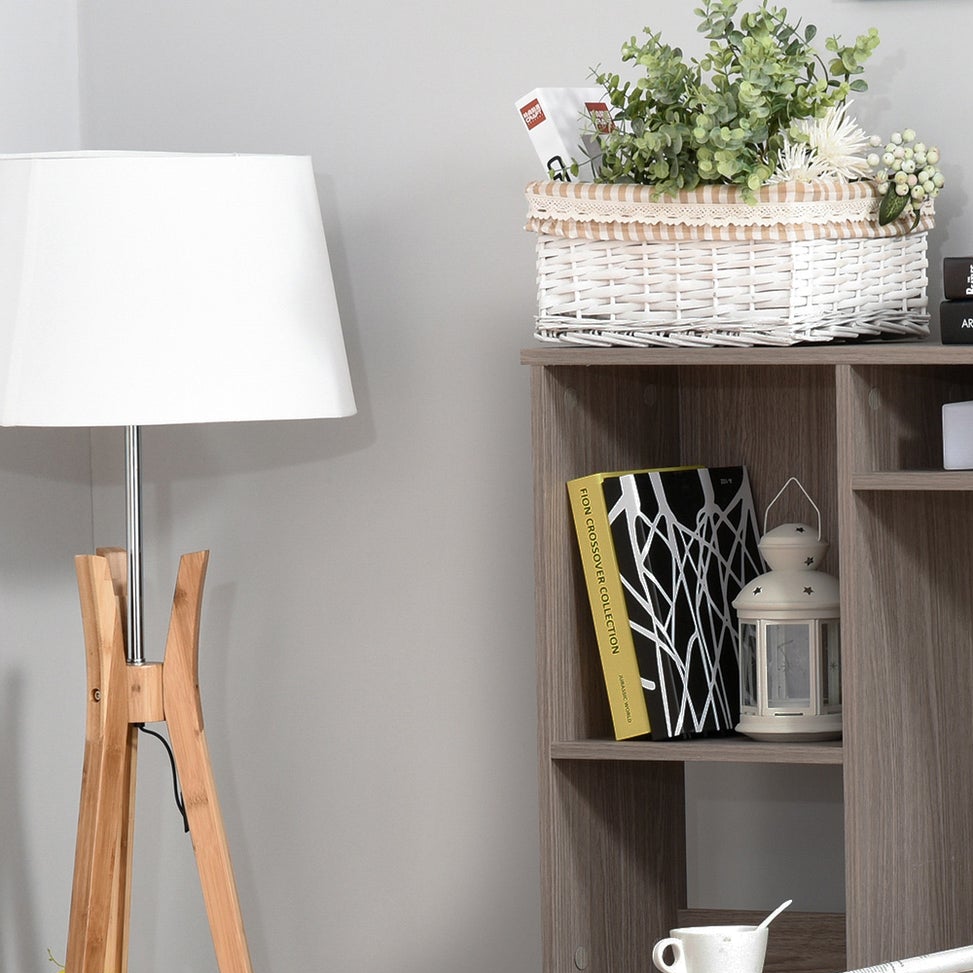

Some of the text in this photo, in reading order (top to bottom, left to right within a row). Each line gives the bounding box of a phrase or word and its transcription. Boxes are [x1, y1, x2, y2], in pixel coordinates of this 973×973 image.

[580, 488, 619, 654] FION CROSSOVER COLLECTION
[624, 701, 632, 723] WORLD
